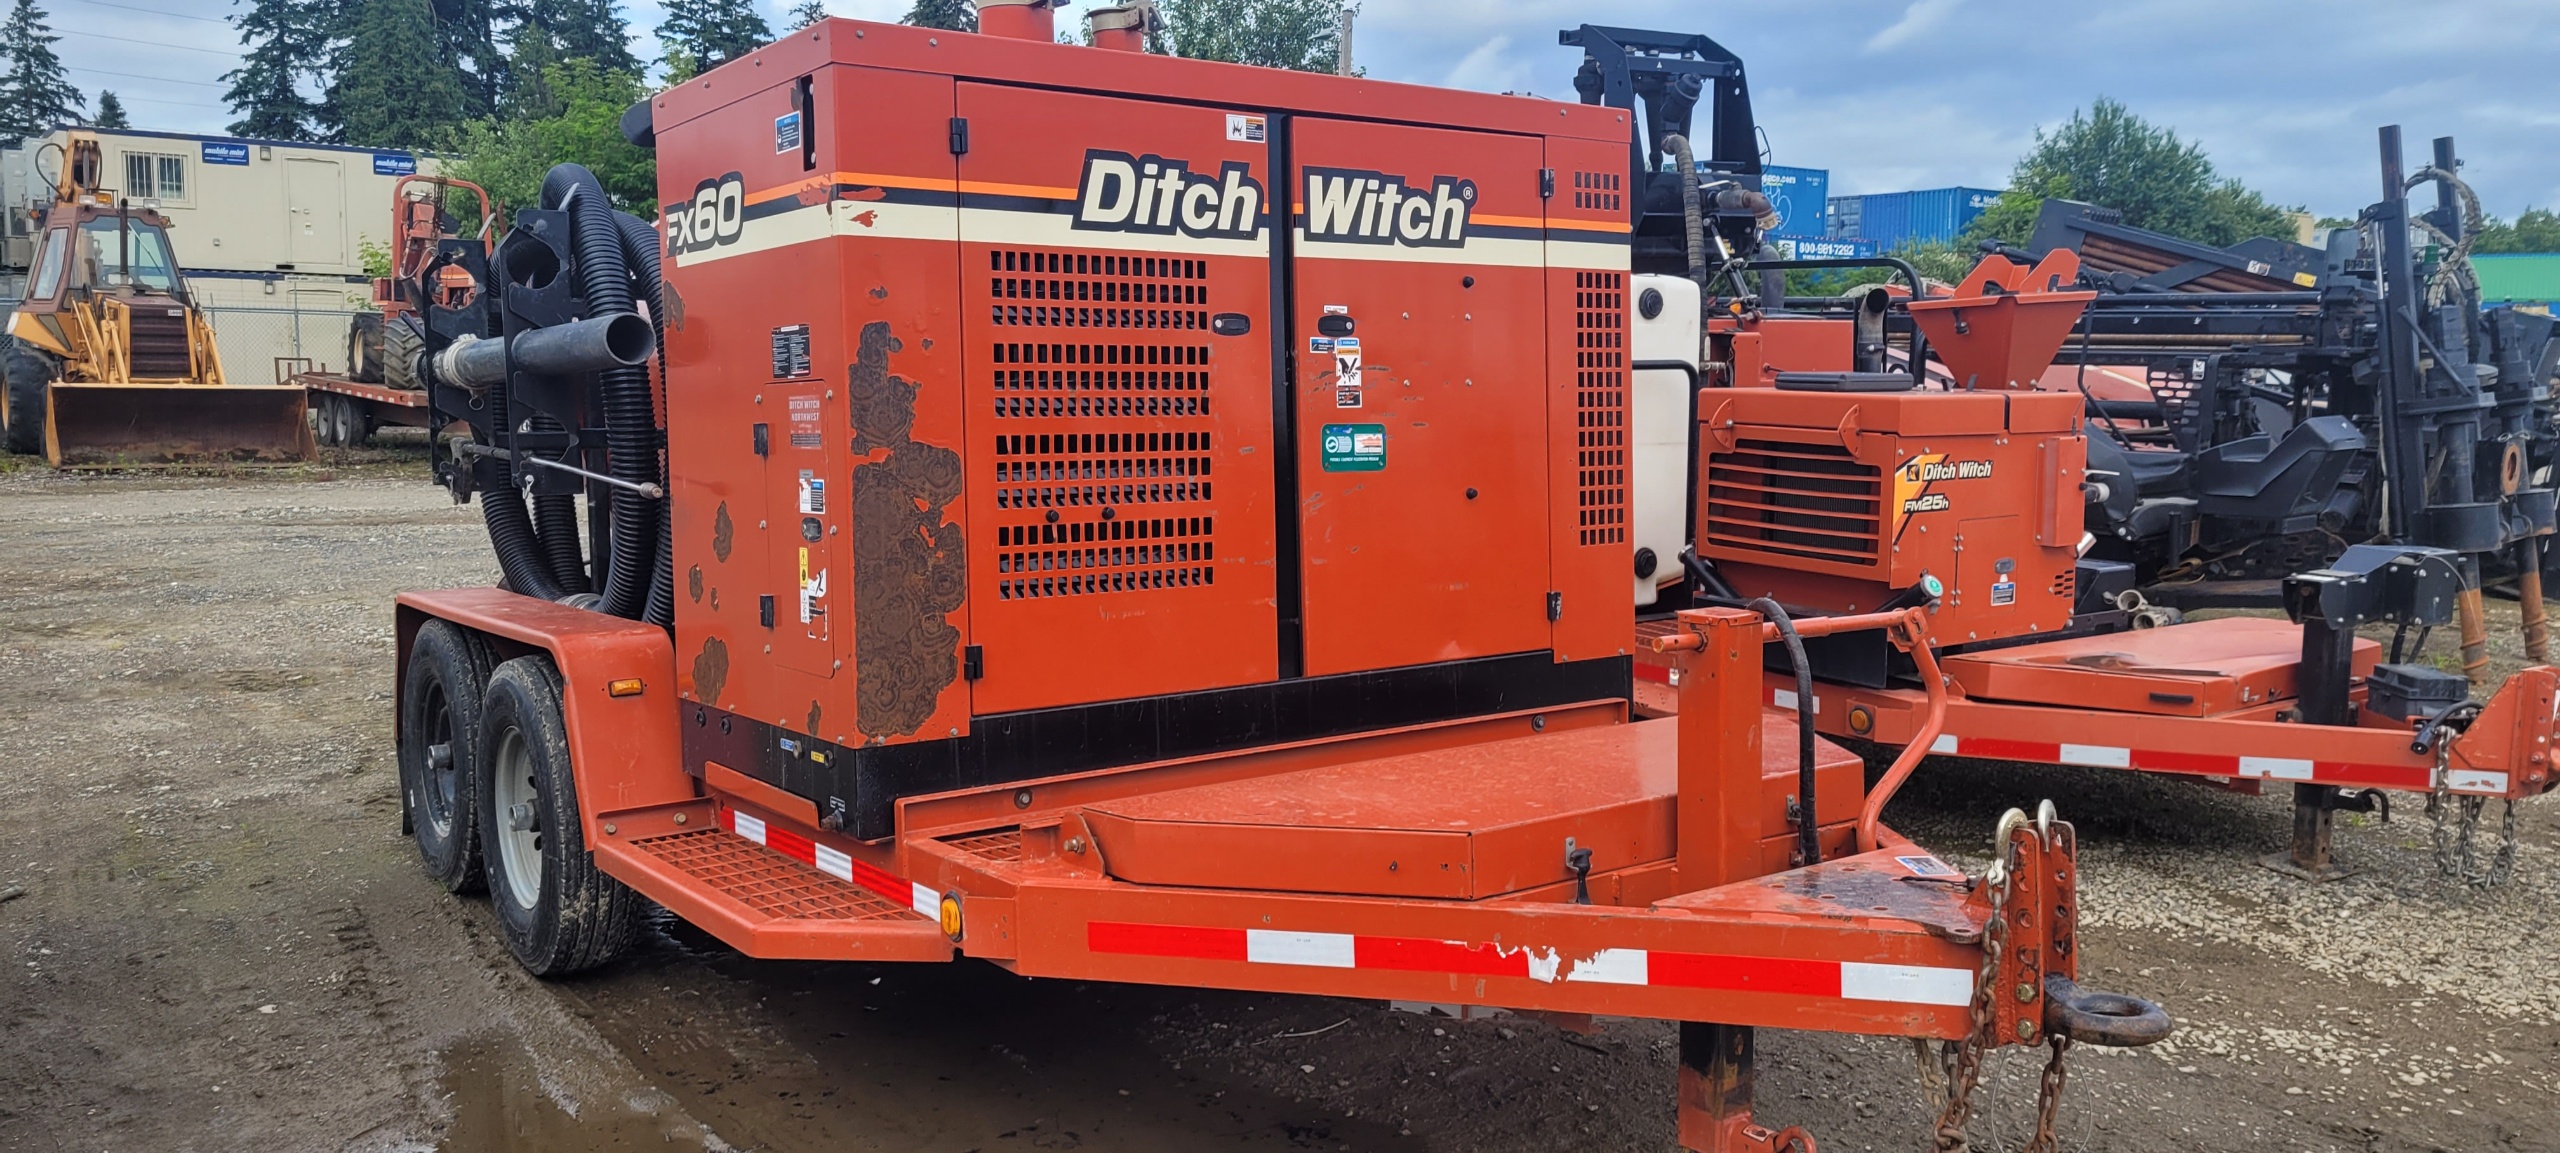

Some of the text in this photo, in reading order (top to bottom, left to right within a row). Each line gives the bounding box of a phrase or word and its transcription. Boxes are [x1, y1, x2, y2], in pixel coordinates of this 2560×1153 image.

[664, 180, 742, 248] FX60
[1079, 156, 1260, 233] Ditch
[1922, 460, 1993, 481] Ditch Witch
[1903, 494, 1950, 513] FM25h
